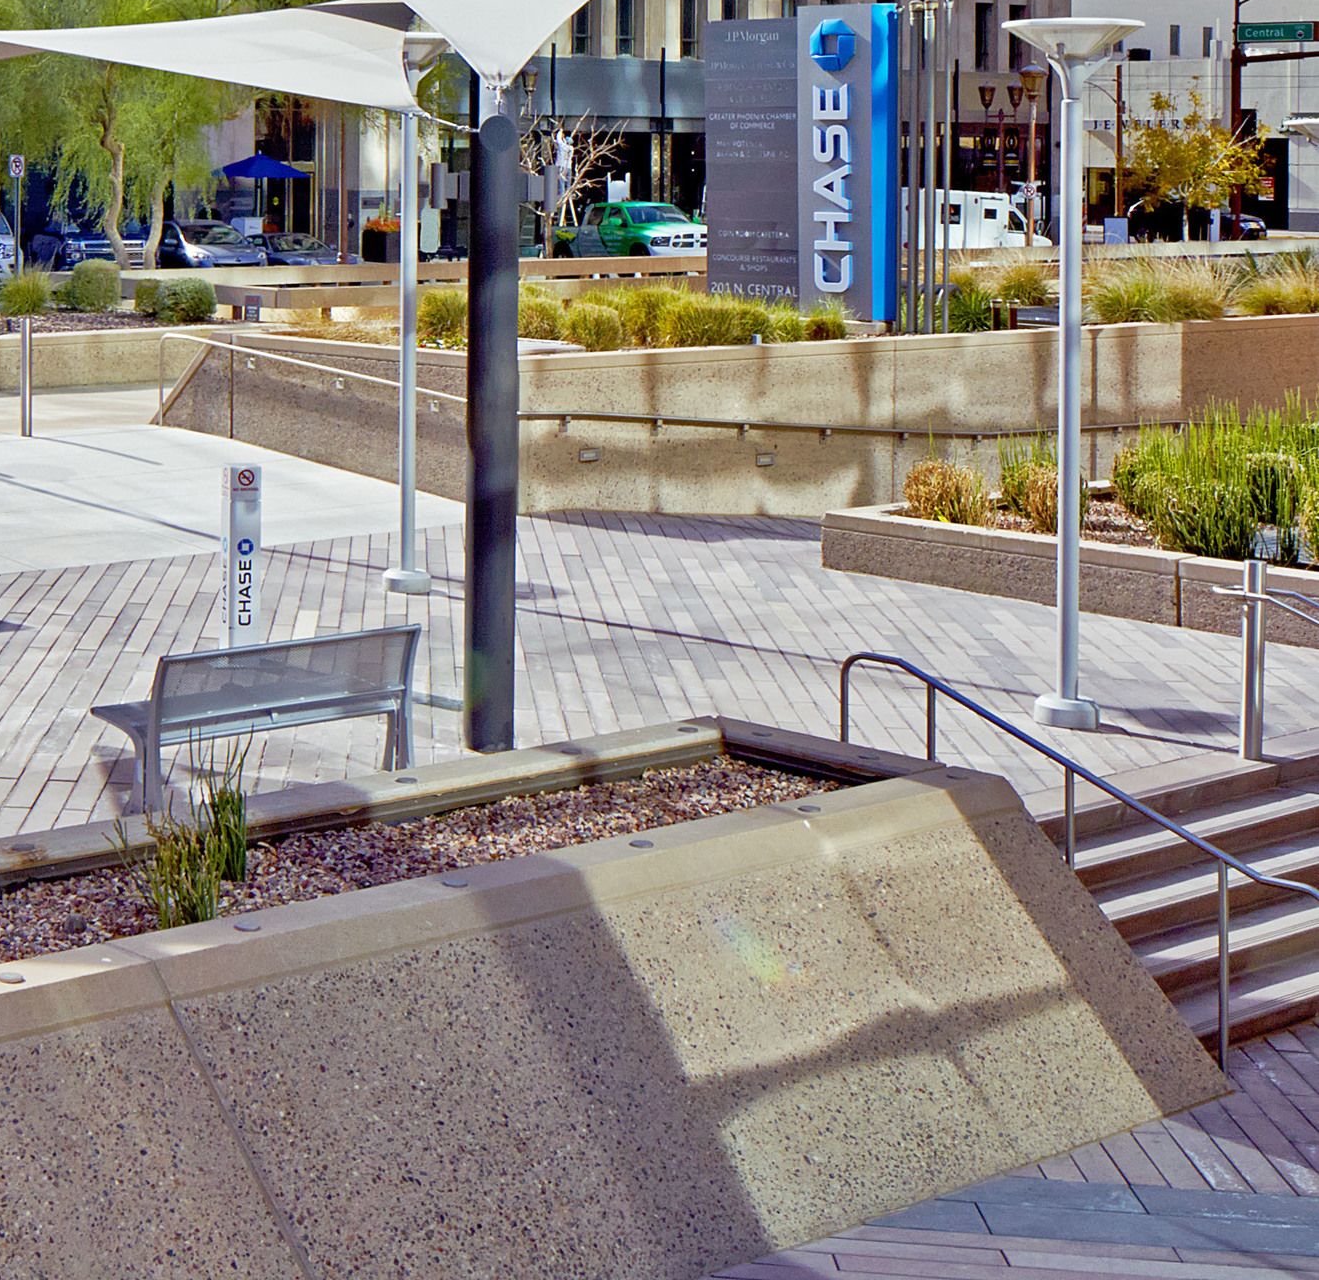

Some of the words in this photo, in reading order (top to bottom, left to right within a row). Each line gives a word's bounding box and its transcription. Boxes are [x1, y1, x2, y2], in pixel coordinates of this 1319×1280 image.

[1245, 28, 1284, 37] Central
[709, 112, 735, 120] GREATER
[730, 122, 738, 130] OF
[740, 122, 775, 130] COMMERCE
[813, 83, 852, 293] CHASE
[711, 282, 730, 293] 201
[747, 284, 798, 297] CENTRAL
[238, 560, 251, 626] CHASE
